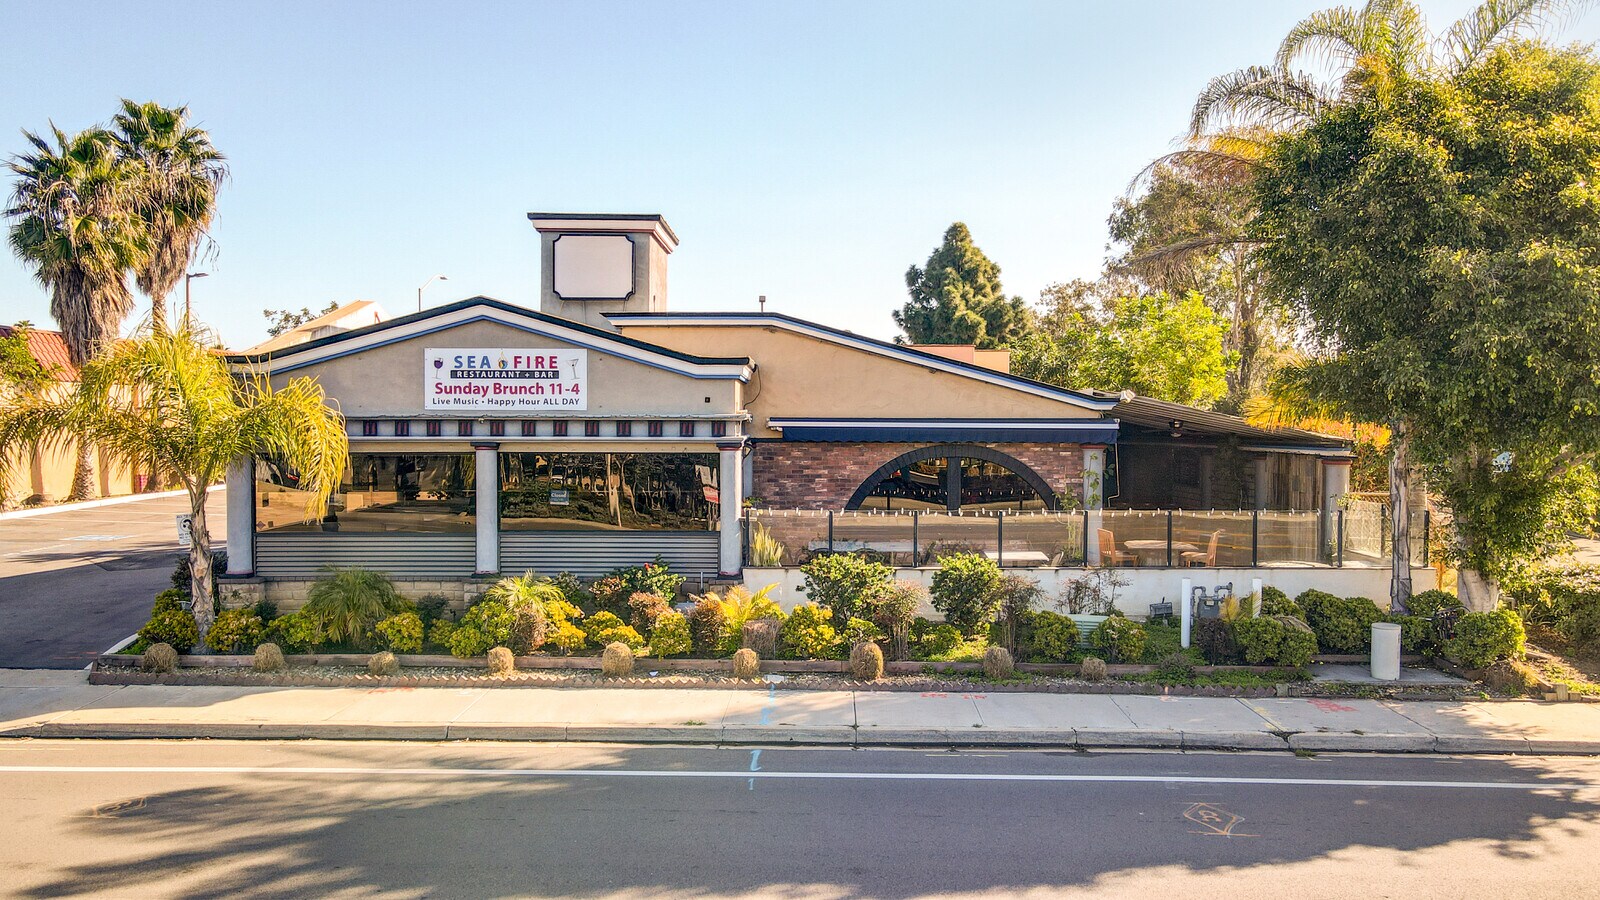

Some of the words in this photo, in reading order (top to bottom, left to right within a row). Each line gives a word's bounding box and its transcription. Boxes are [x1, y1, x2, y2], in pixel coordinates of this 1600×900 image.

[454, 355, 491, 369] SEA
[513, 355, 558, 369] FIRE
[435, 381, 490, 398] Sunday
[493, 382, 544, 395] Brunch
[549, 383, 580, 395] 11-4
[487, 398, 516, 407] Happy
